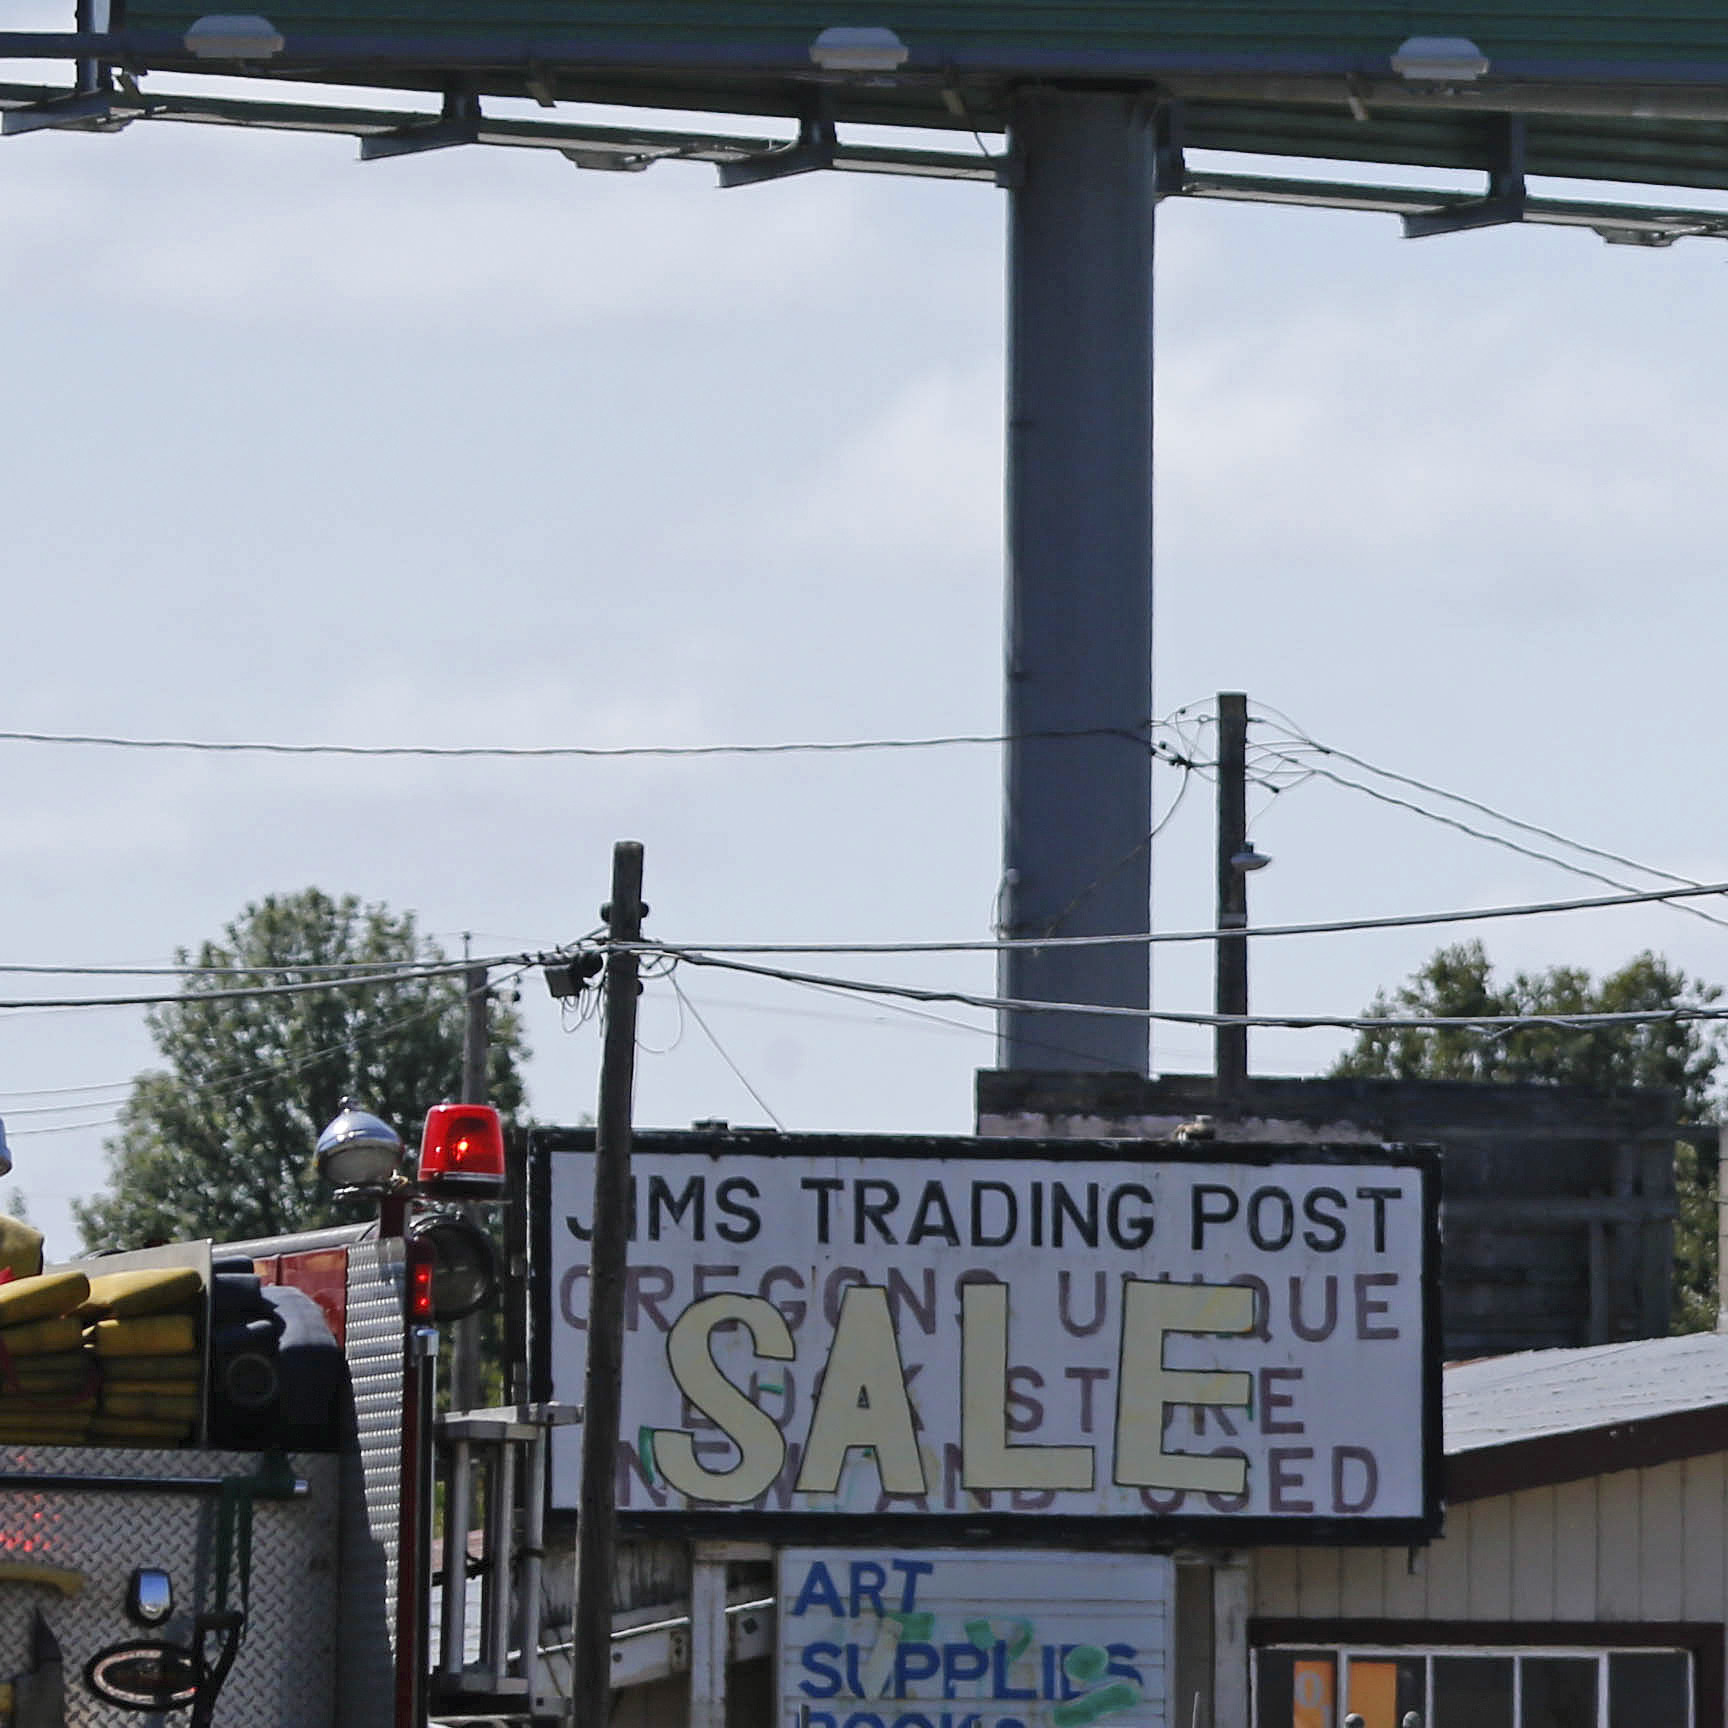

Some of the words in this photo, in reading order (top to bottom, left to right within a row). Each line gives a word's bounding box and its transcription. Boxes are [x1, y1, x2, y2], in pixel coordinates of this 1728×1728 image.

[800, 1176, 1156, 1251] TRADING
[1190, 1183, 1403, 1254] POST
[559, 1263, 1000, 1336] OREGON
[1057, 1269, 1401, 1344] UQUE
[652, 1278, 1256, 1504] SALE
[1005, 1365, 1306, 1436] STE
[791, 1558, 934, 1619] ART
